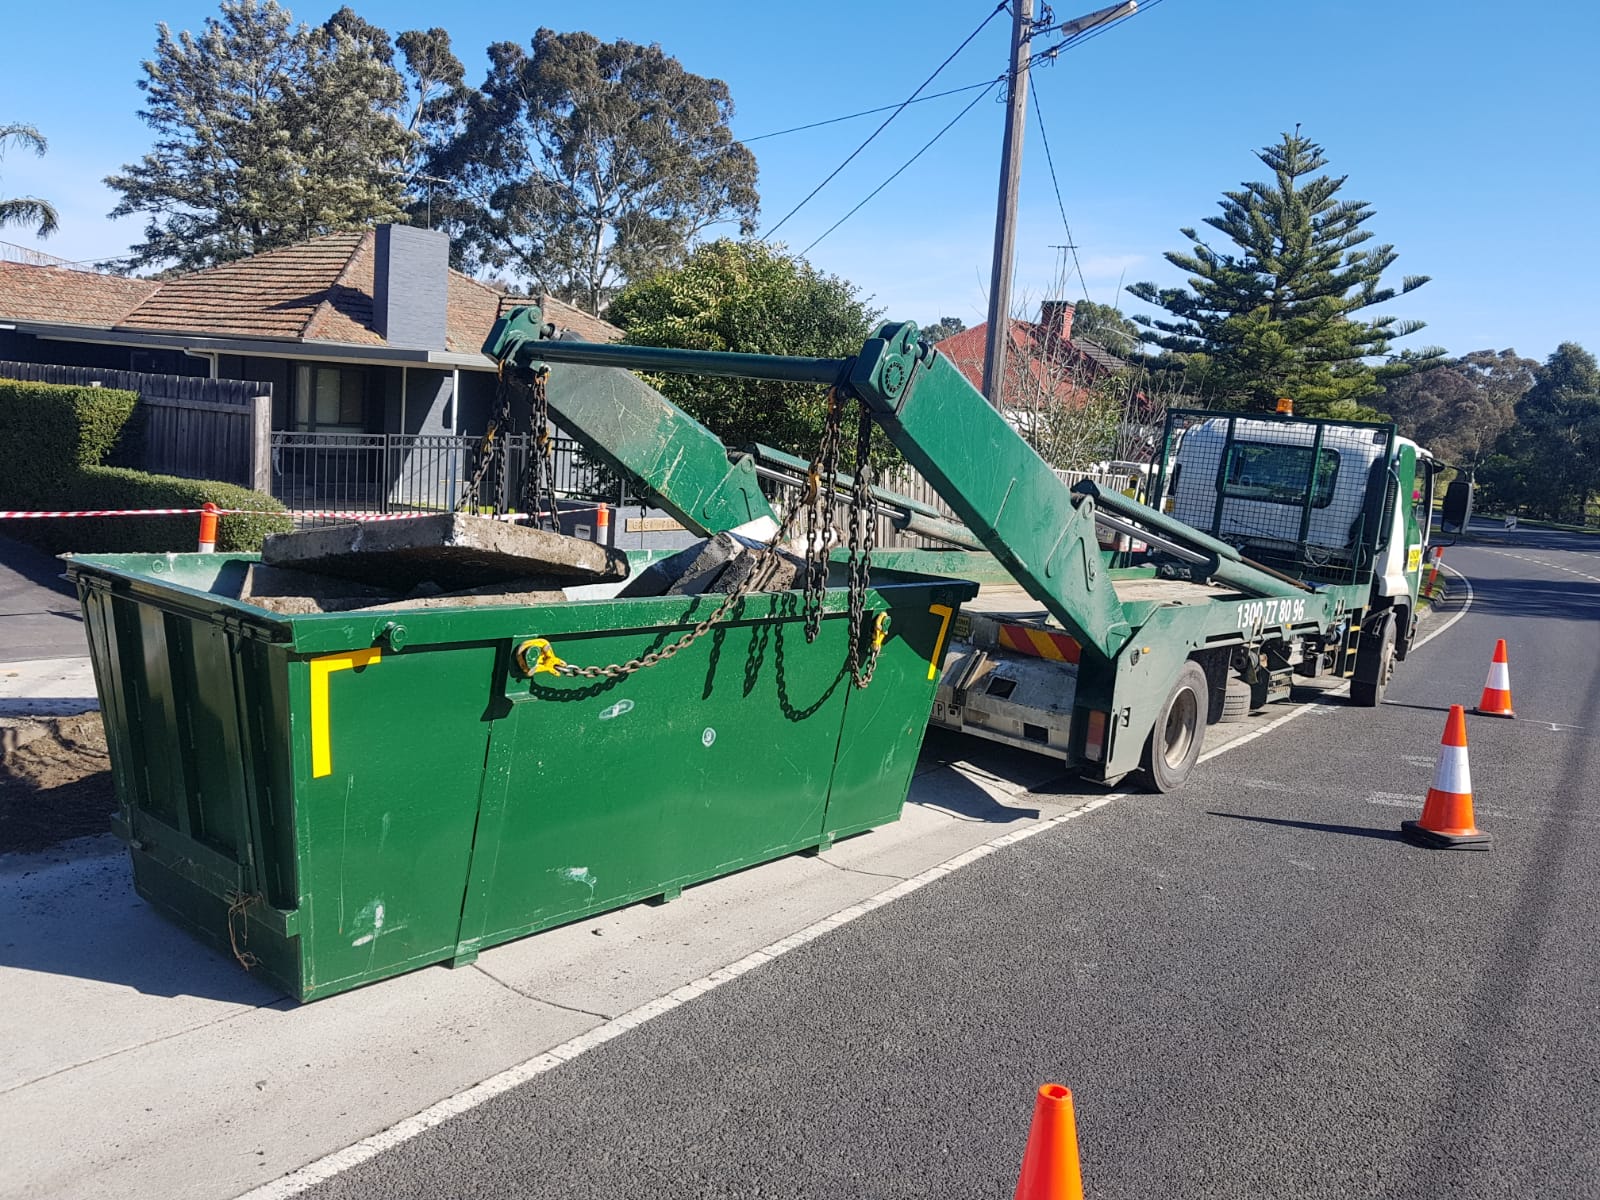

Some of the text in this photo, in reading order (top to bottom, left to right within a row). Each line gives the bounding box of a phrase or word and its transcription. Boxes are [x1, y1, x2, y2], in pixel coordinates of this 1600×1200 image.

[1237, 599, 1305, 628] 1300 77 80 96
